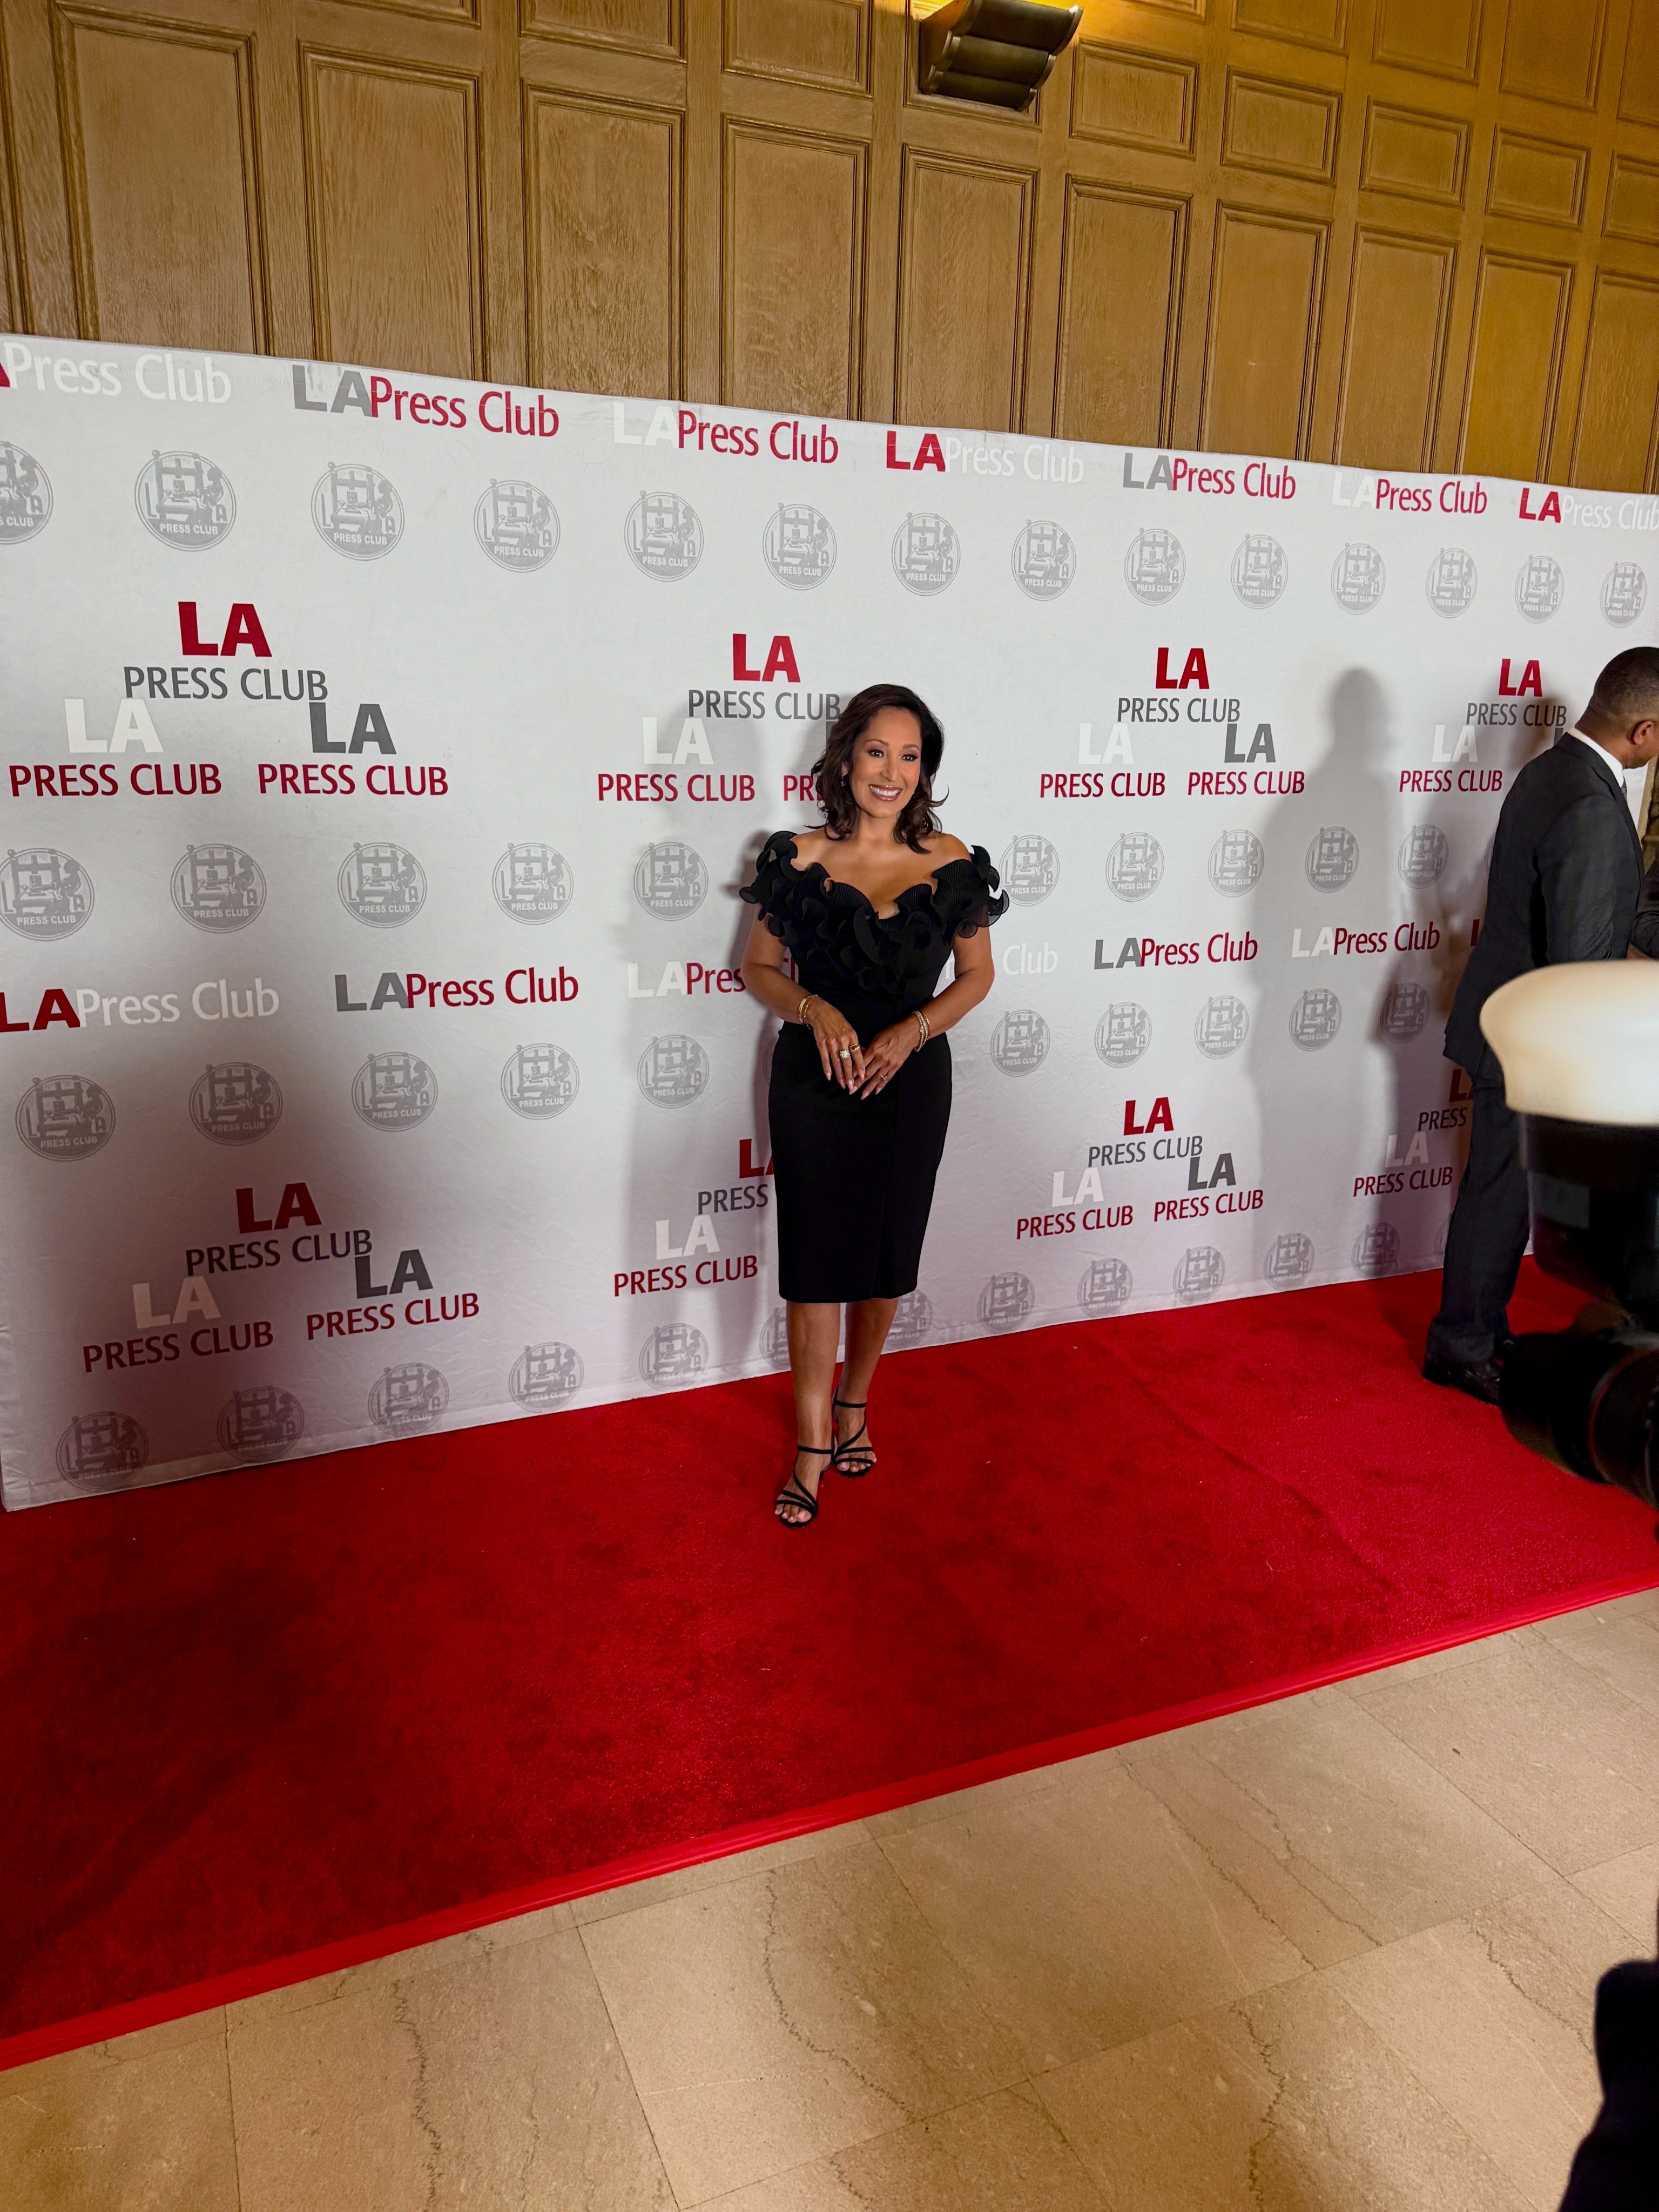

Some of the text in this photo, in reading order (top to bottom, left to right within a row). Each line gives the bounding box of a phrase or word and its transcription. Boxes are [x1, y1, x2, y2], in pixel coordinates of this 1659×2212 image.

[136, 353, 231, 404] Club
[479, 390, 559, 437] Club
[770, 421, 838, 463] Club
[1024, 442, 1084, 483] Club
[1244, 462, 1296, 499] Club
[1439, 481, 1487, 514] Club
[6, 516, 34, 527] CLUB
[160, 523, 218, 536] PRESS CLUB
[1618, 500, 1659, 530] Club
[334, 533, 387, 545] PRESS CLUB
[494, 546, 544, 557] PRESS CLUB
[643, 556, 688, 567] PRESS CLUB
[779, 566, 821, 576] PRESS CLUB
[906, 572, 946, 582] PRESS CLUB
[1025, 578, 1062, 588] PRESS CLUB
[1157, 584, 1172, 592] CLUB
[178, 601, 272, 657] LA
[733, 633, 801, 683] LA
[1156, 647, 1210, 690] LA
[123, 666, 328, 701] PRESS CLUB
[1499, 658, 1542, 697] LA
[689, 689, 840, 720] PRESS CLUB
[1117, 698, 1240, 723] PRESS CLUB
[1466, 703, 1567, 727] PRESS CLUB
[64, 698, 164, 753] LA
[309, 702, 396, 754] LA
[643, 717, 714, 765] LA
[1078, 723, 1134, 765] LA
[1224, 723, 1276, 763] LA
[1432, 725, 1478, 763] LA
[9, 764, 221, 797] PRESS CLUB
[258, 764, 448, 795] PRESS CLUB
[598, 773, 678, 801] PRESS
[687, 774, 755, 801] CLUB
[1040, 772, 1165, 798] PRESS CLUB
[1188, 771, 1305, 795] PRESS CLUB
[1399, 770, 1502, 792] PRESS CLUB
[194, 908, 249, 918] PRESS CLUB
[359, 904, 410, 914] PRESS CLUB
[538, 902, 558, 911] CLUB
[650, 899, 693, 907] PRESS CLUB
[17, 915, 76, 926] PRESS CLUB
[1394, 921, 1440, 952] Club
[1002, 941, 1058, 976] Club
[1207, 931, 1258, 963] Club
[192, 977, 279, 1020] Club
[505, 966, 579, 1004] Club
[653, 1087, 695, 1097] PRESS CLUB
[1449, 1069, 1473, 1102] L
[372, 1108, 422, 1120] PRESS CLUB
[519, 1097, 564, 1108] PRESS CLUB
[1123, 1097, 1174, 1136] LA
[1418, 1107, 1468, 1131] PRESS
[41, 1136, 97, 1149] PRESS CLUB
[212, 1121, 266, 1132] PRESS CLUB
[739, 1138, 774, 1178] L
[1088, 1136, 1203, 1167] PRESS CLUB
[1385, 1131, 1429, 1168] LA
[1051, 1167, 1104, 1208] LA
[1188, 1152, 1236, 1191] LA
[1353, 1166, 1453, 1197] PRESS CLUB
[235, 1182, 322, 1233] LA
[698, 1184, 768, 1215] PRESS
[1154, 1189, 1263, 1222] PRESS CLUB
[656, 1214, 720, 1260] LA
[1016, 1205, 1133, 1239] PRESS CLUB
[186, 1229, 372, 1276] PRESS CLUB
[354, 1249, 433, 1299] LA
[614, 1255, 758, 1297] PRESS CLUB
[132, 1275, 221, 1329] LA
[307, 1293, 480, 1340] PRESS CLUB
[83, 1321, 273, 1373] PRESS CLUB
